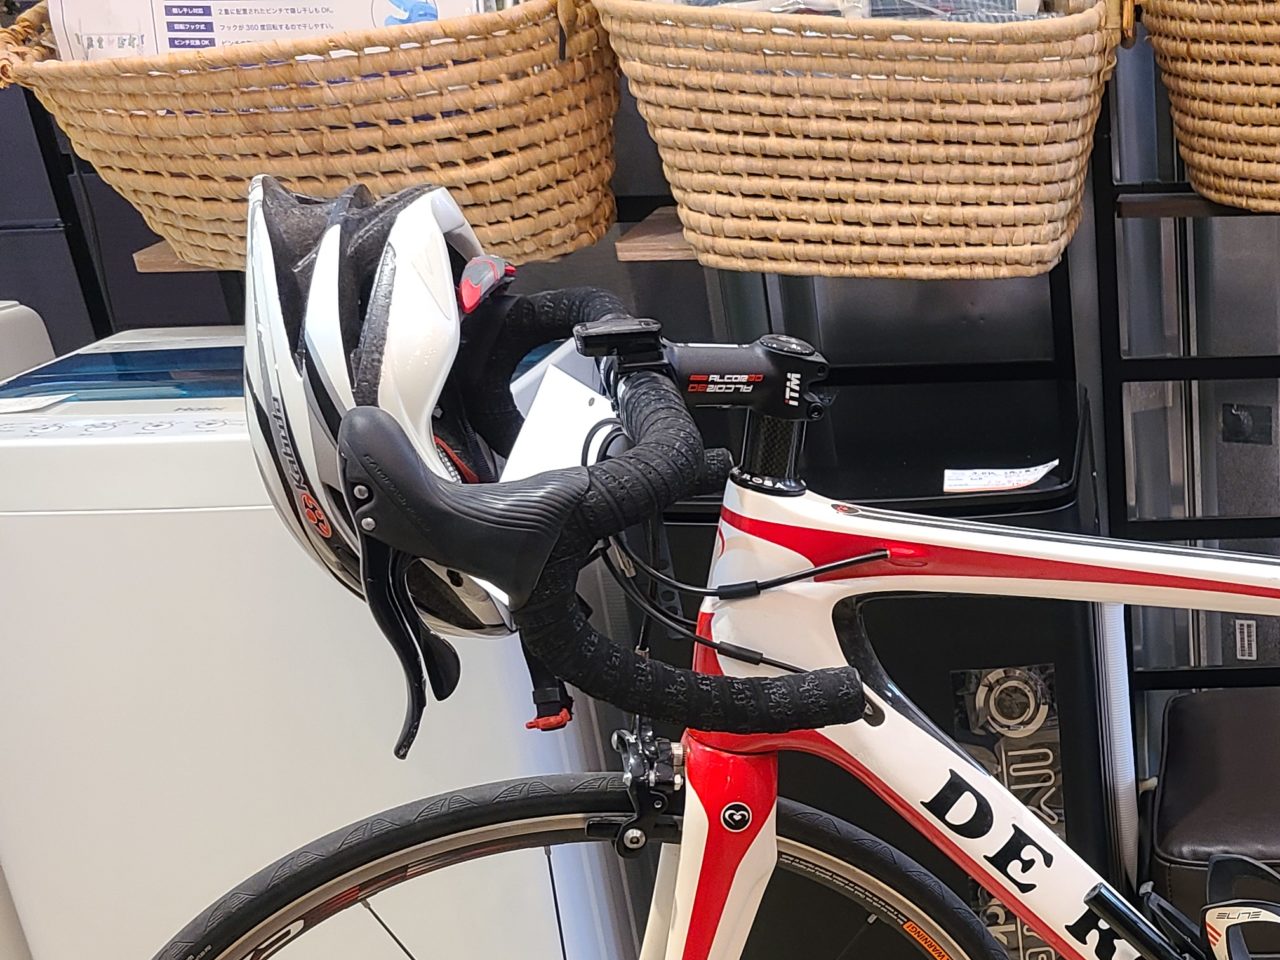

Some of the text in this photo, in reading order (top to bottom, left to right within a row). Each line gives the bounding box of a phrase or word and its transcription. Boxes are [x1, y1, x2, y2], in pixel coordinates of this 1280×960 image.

[920, 768, 1053, 894] DE
[1215, 911, 1263, 920] ELITE
[906, 923, 946, 960] WARNING!
